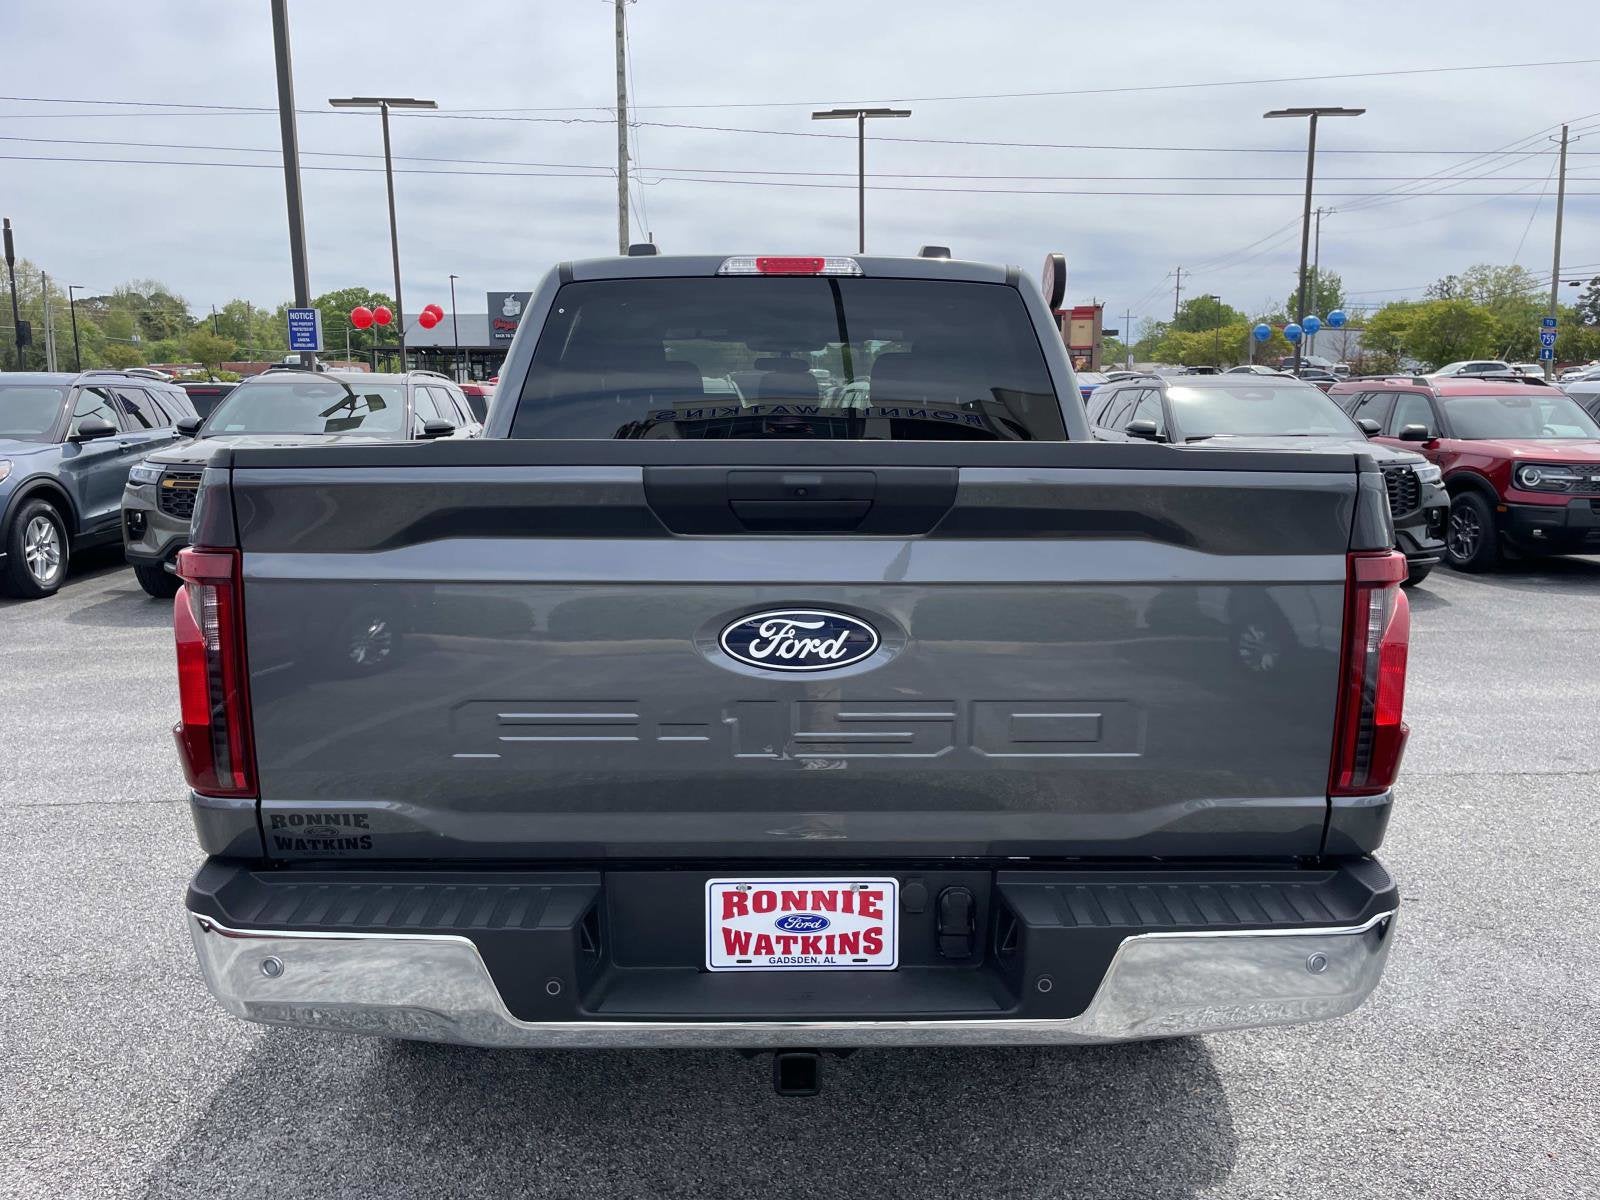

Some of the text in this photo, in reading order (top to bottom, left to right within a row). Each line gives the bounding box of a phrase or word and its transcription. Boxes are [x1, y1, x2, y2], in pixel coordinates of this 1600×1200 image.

[290, 312, 314, 320] NOTICE
[1542, 334, 1554, 344] 759
[748, 618, 850, 659] Ford
[270, 813, 370, 829] RONNIE
[273, 835, 373, 850] WATKINS
[721, 890, 883, 920] RONNIE
[783, 915, 822, 930] Ford
[721, 926, 883, 956] WATKINS
[769, 956, 837, 965] GADSDEN, AL
